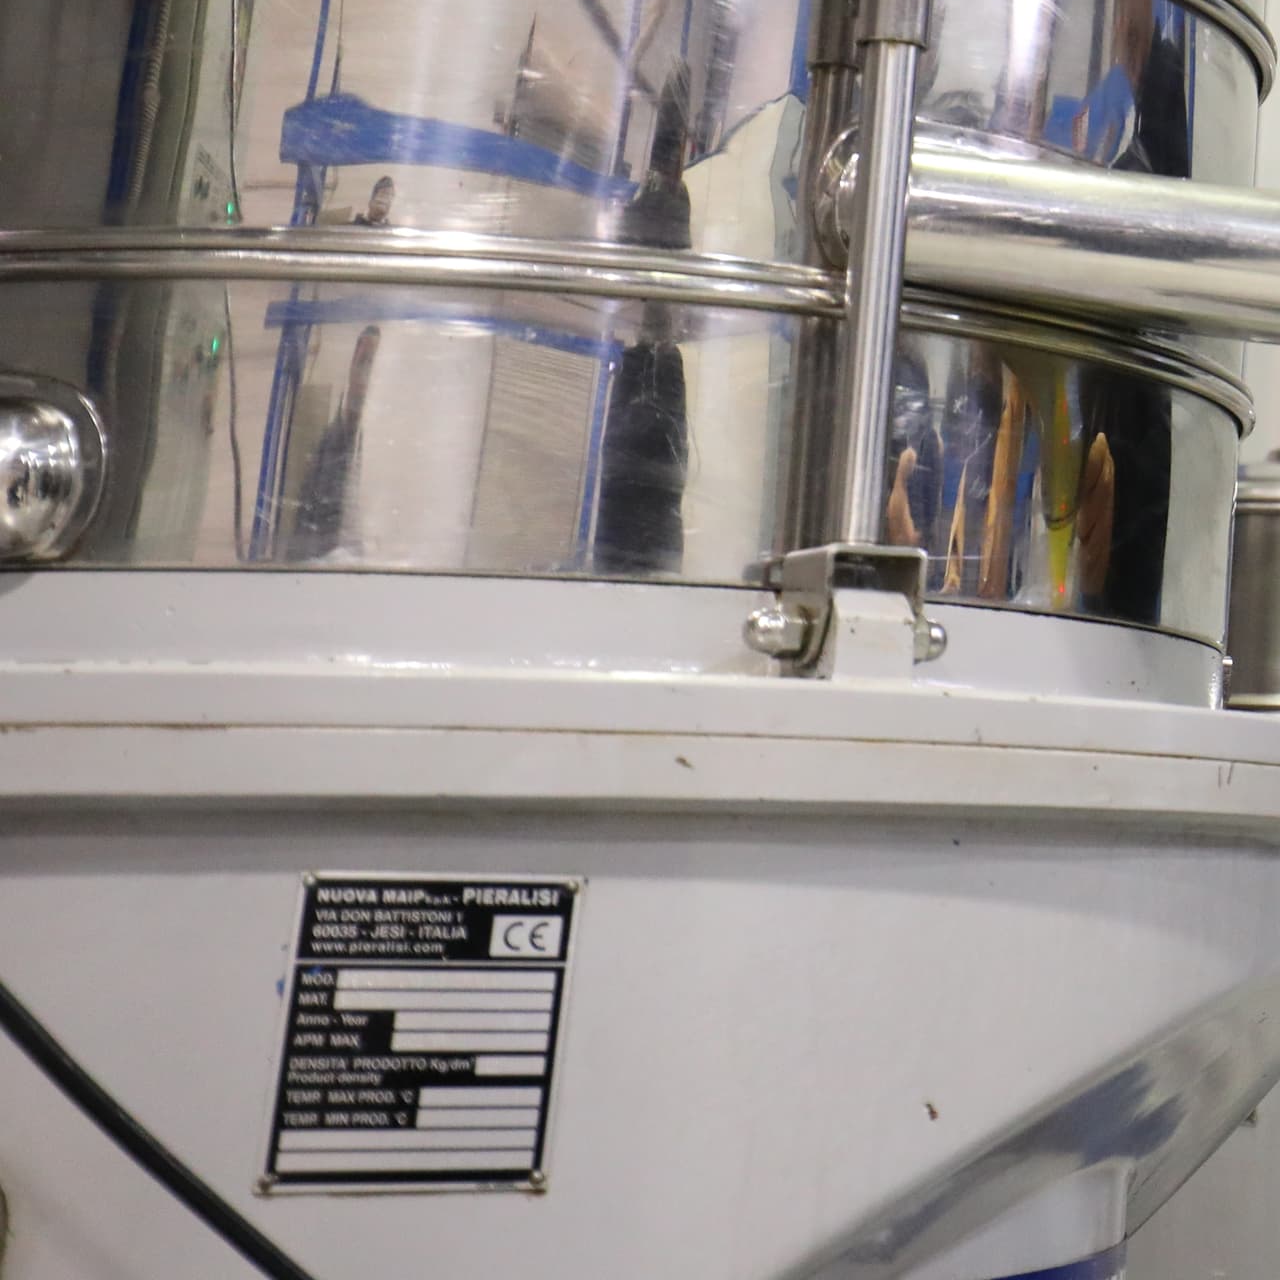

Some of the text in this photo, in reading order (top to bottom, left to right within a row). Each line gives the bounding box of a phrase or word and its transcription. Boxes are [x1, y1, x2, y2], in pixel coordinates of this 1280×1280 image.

[317, 887, 377, 904] NUOVA
[462, 887, 560, 907] PIERALISI
[315, 909, 337, 922] VIA
[341, 909, 370, 922] DON
[312, 924, 467, 940] 60035 JESI ITALIA
[503, 921, 549, 951] CE
[311, 941, 443, 954] www.pieralisi.com
[327, 1091, 356, 1104] MAX
